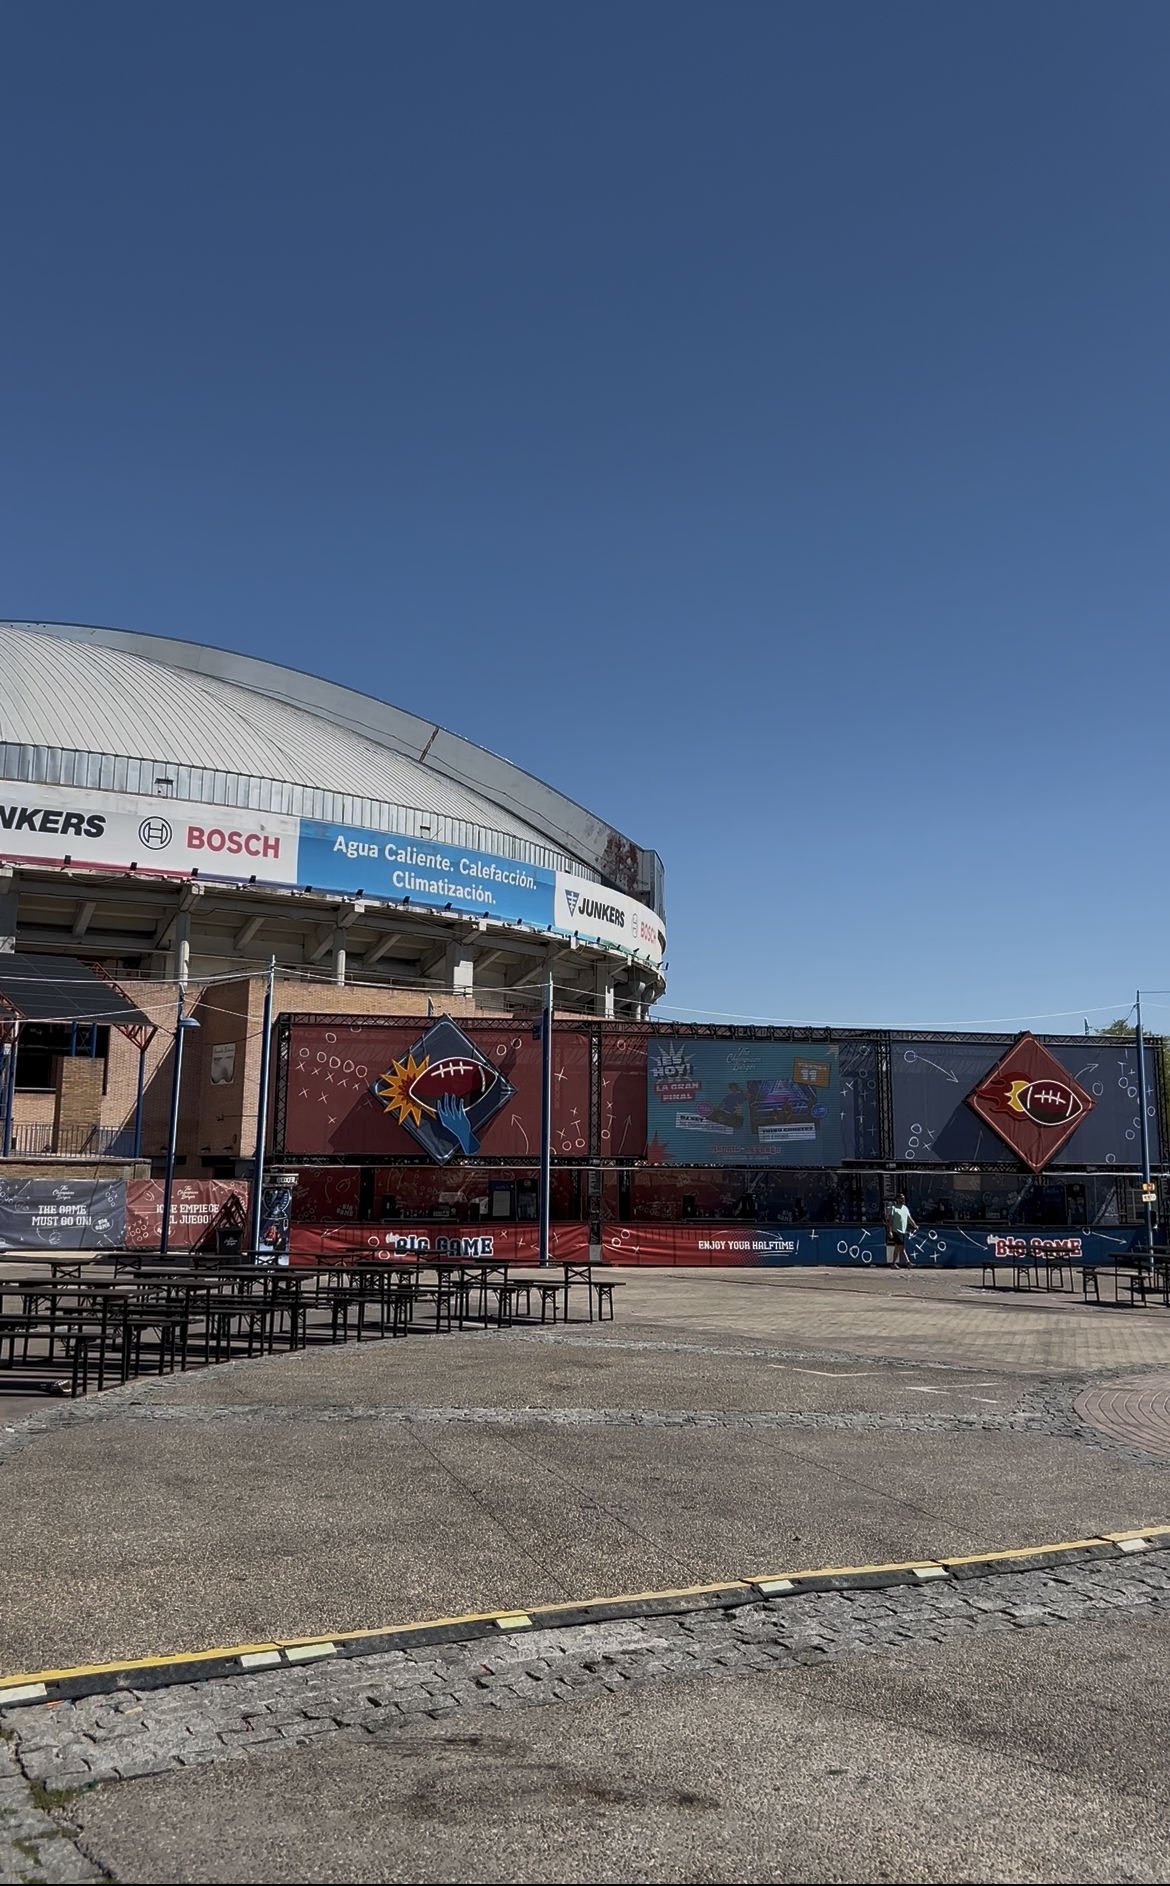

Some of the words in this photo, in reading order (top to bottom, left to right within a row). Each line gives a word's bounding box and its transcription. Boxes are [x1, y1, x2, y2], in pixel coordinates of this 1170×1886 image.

[186, 825, 280, 859] BOSCH
[333, 835, 379, 860] Agua
[384, 843, 454, 872] Caliente.
[459, 858, 537, 891] Calefacción.
[392, 869, 496, 905] Climatización.
[578, 897, 625, 929] JUNKERS
[801, 1069, 817, 1082] 11
[656, 1084, 669, 1092] LA
[671, 1082, 699, 1090] GRAN
[662, 1093, 693, 1101] FINAL
[38, 1205, 57, 1214] THE
[59, 1205, 87, 1214] GAME
[180, 1204, 220, 1213] EMPIECE
[31, 1216, 59, 1226] MUST
[60, 1216, 74, 1226] GO
[76, 1216, 92, 1226] ON!
[394, 1234, 431, 1256] BIG
[435, 1235, 494, 1258] GAME
[698, 1240, 725, 1250] ENJOY
[728, 1240, 750, 1250] YOUR
